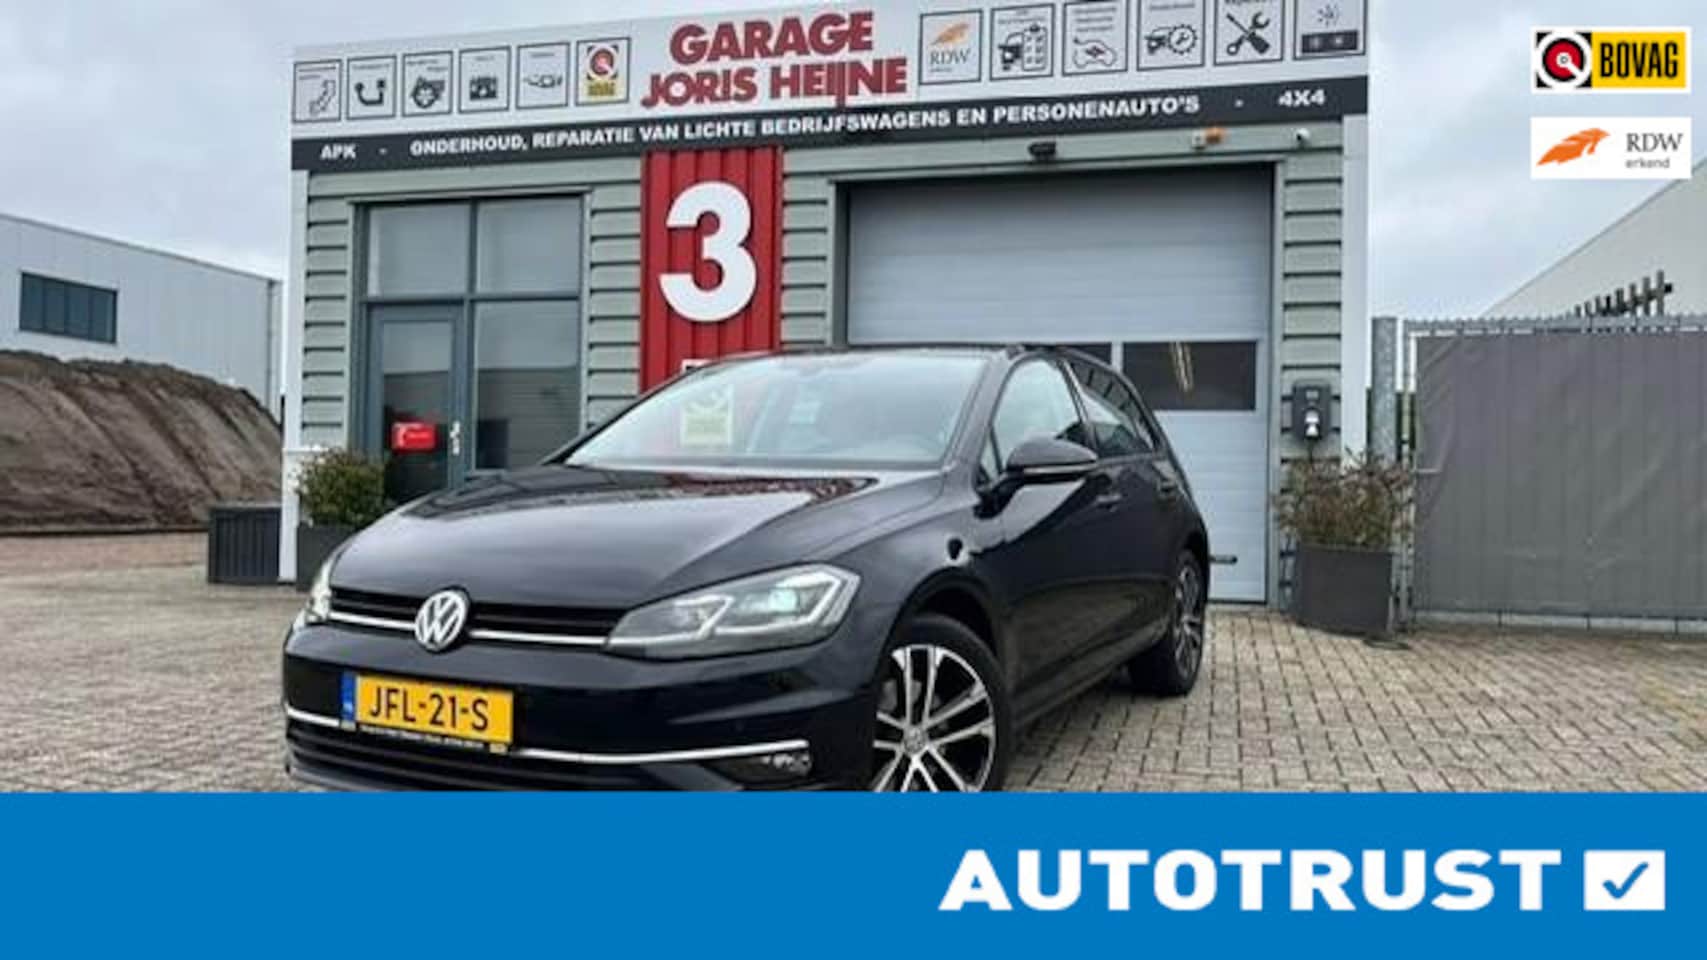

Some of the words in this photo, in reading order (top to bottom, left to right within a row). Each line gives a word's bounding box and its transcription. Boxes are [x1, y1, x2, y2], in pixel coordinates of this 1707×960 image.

[670, 11, 874, 65] GARAGE
[641, 67, 758, 107] JORIS
[320, 143, 357, 159] APK
[410, 134, 528, 156] ONDERHOUD,
[532, 126, 635, 149] REPARATIE
[639, 123, 679, 141] VAN
[684, 118, 755, 139] LICHTE
[761, 110, 951, 136] BEDRIJFSWAGENS
[956, 107, 987, 126] EN
[993, 95, 1200, 123] PERSONENAUTO'S
[659, 181, 756, 321] 3
[370, 687, 489, 732] JFL-21-S
